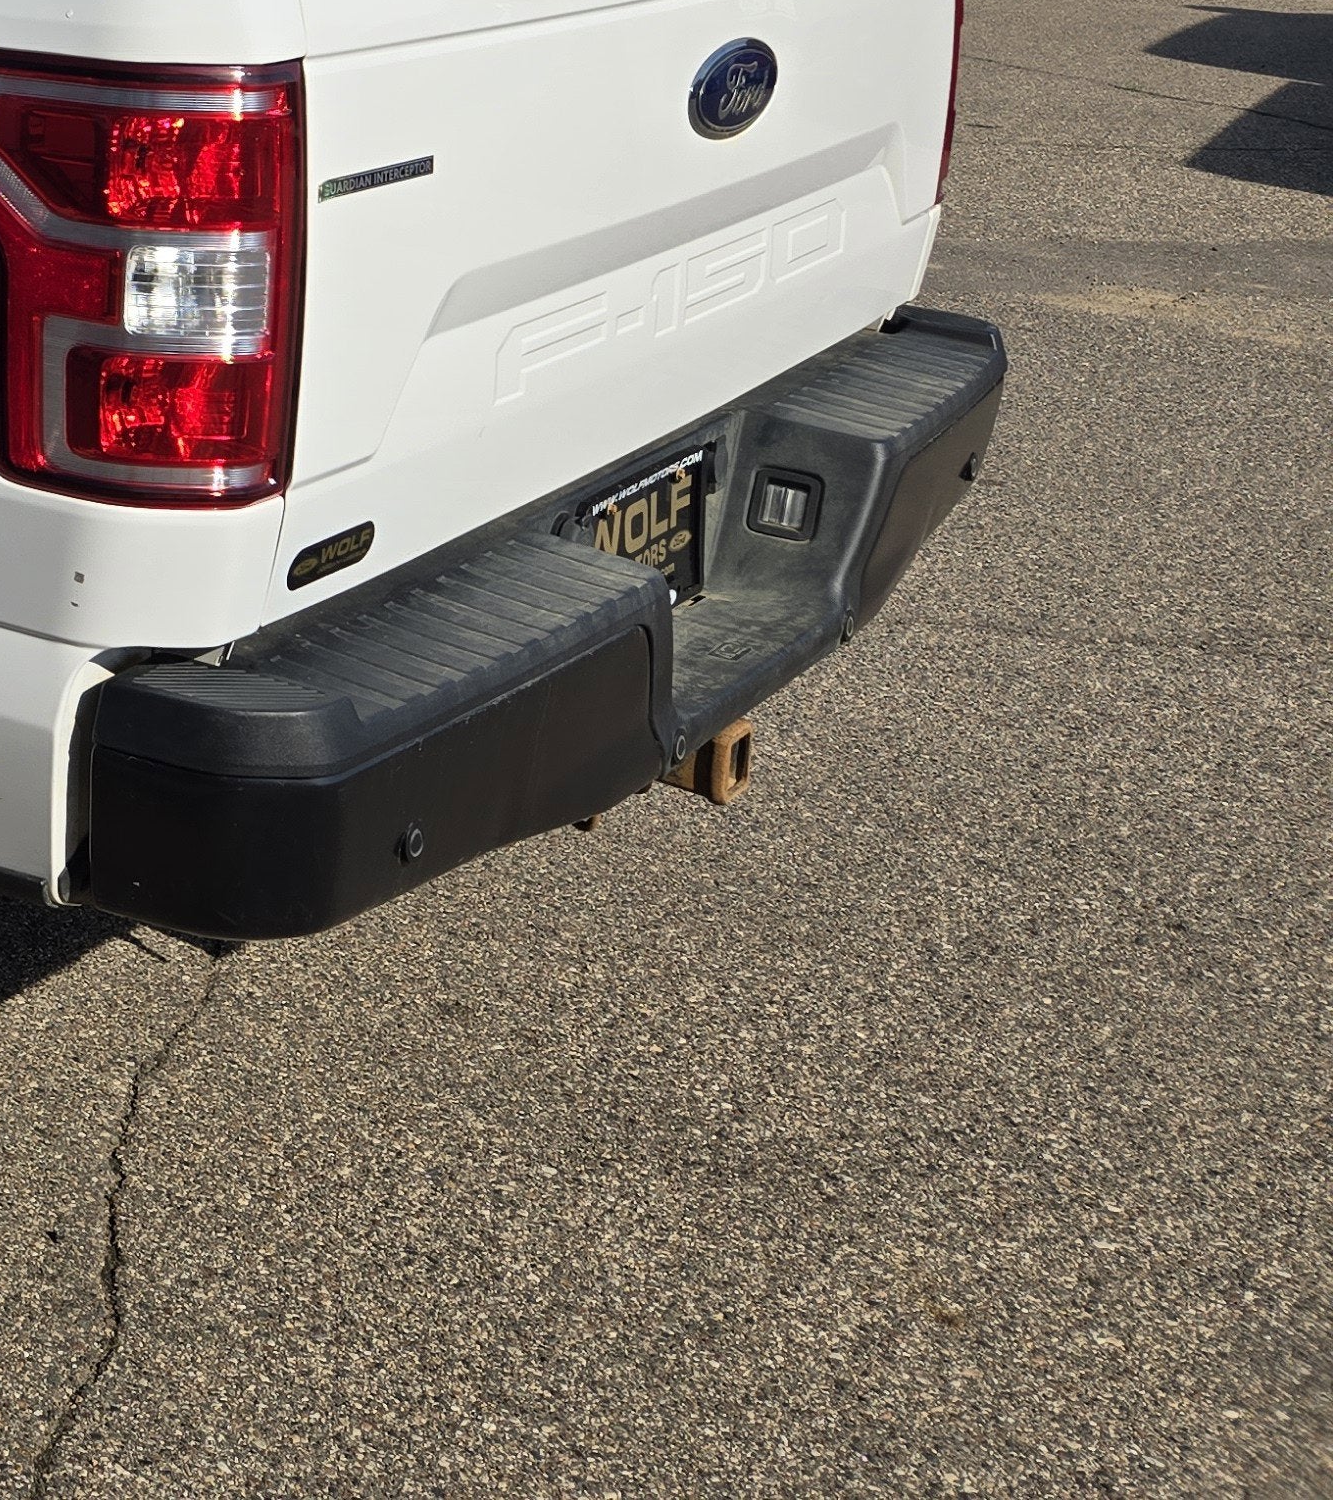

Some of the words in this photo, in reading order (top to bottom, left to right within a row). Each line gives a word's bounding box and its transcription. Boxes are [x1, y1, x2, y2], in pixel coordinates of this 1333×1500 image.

[717, 61, 769, 120] Ford
[321, 174, 372, 197] GUARDIAN
[373, 160, 432, 185] INTERCEPTOR
[494, 197, 847, 406] F-150
[593, 474, 693, 556] WOLF
[320, 528, 373, 564] WOLF
[634, 538, 667, 567] TORS
